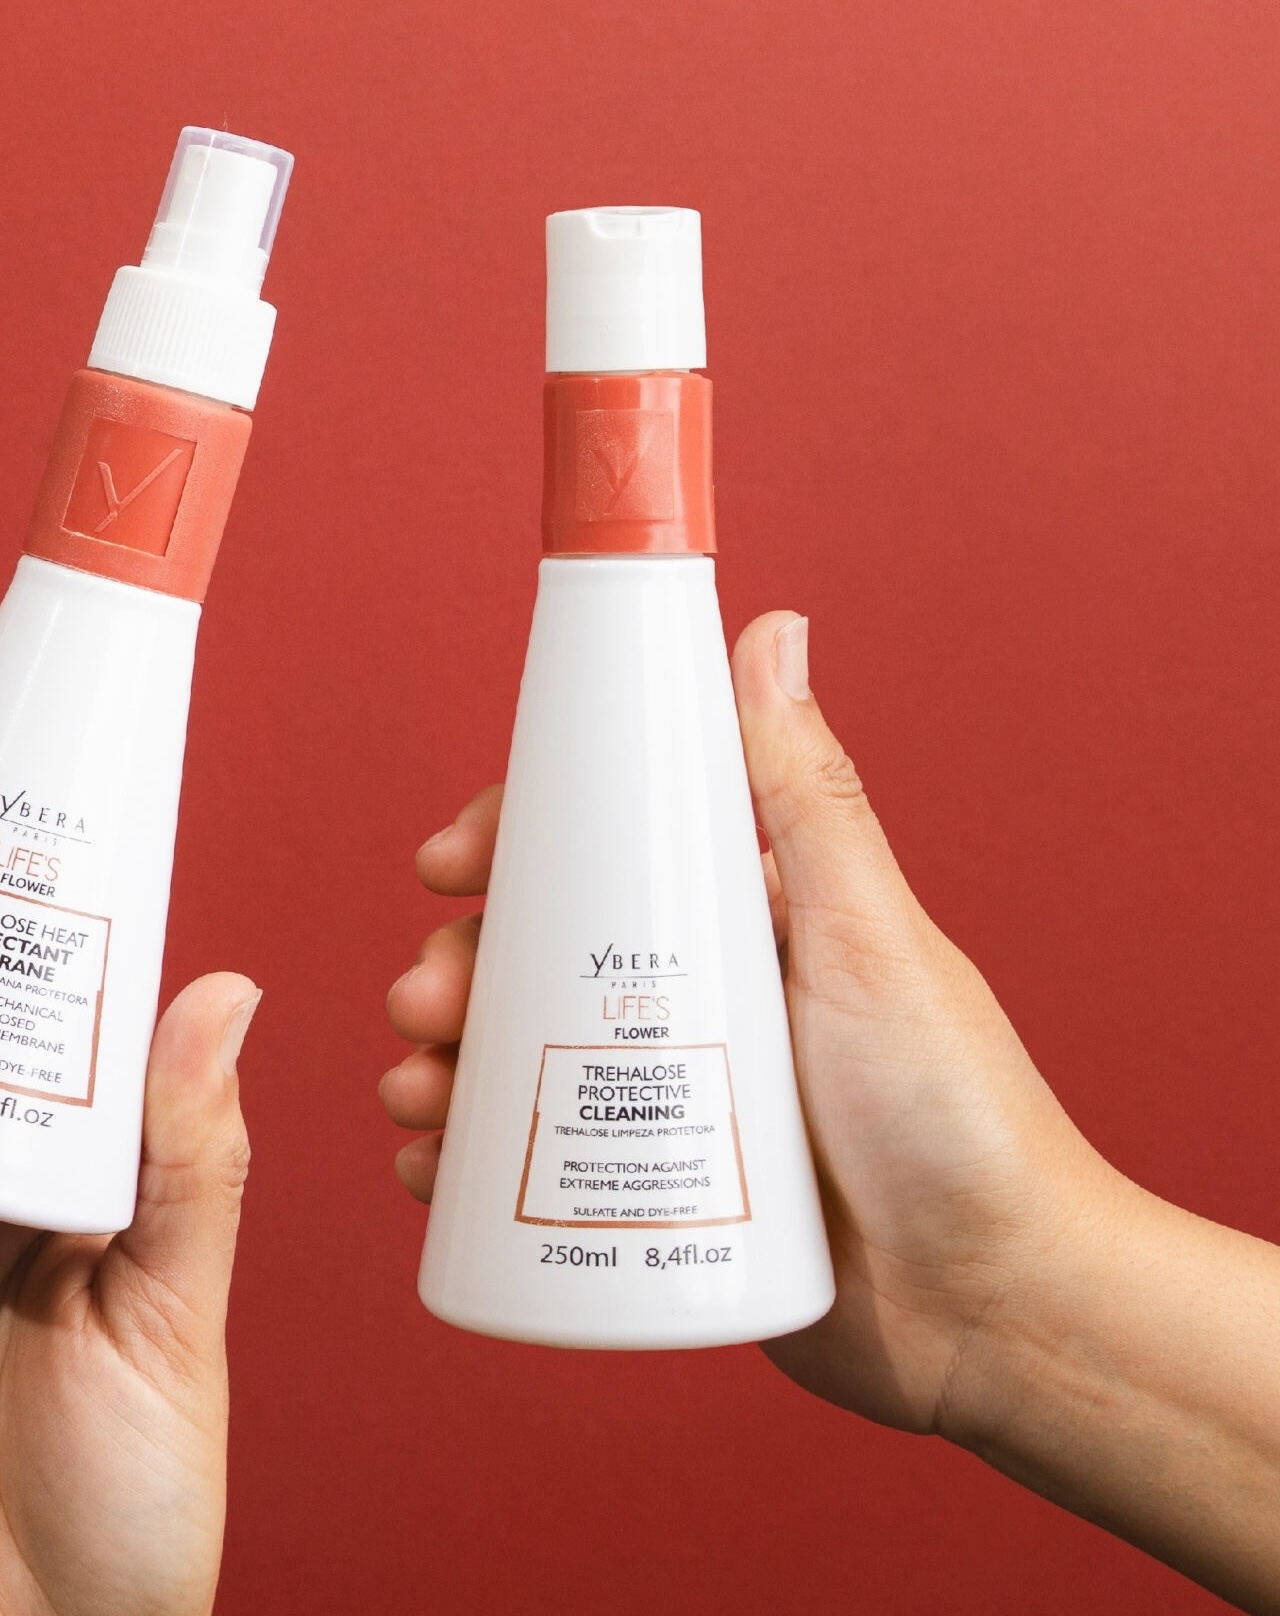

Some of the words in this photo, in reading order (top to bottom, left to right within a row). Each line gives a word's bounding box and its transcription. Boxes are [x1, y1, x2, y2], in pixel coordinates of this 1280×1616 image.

[0, 790, 86, 834] YBERA
[12, 826, 58, 846] PARIS
[0, 873, 56, 898] FLOWER
[41, 924, 89, 949] HEAT
[590, 943, 679, 978] YBERA
[612, 980, 656, 989] PARIS
[25, 984, 88, 1006] PROTETORA
[602, 996, 671, 1020] LIFE'S
[614, 1027, 670, 1039] FLOWER
[583, 1064, 686, 1081] TREHALOSE
[578, 1084, 691, 1102] PROTECTIVE
[579, 1105, 685, 1121] CLEANING
[554, 1126, 609, 1137] TREHALOSE
[612, 1127, 655, 1138] LIMPEZA
[657, 1124, 715, 1136] PROTETORA
[563, 1161, 648, 1173] PROTECTION
[651, 1159, 706, 1173] AGAINST
[560, 1178, 620, 1190] EXTREME
[622, 1176, 711, 1190] AGGRESSIONS
[573, 1206, 618, 1217] SULFATE
[620, 1207, 645, 1217] AND
[648, 1205, 697, 1217] DYE-FREE
[540, 1244, 617, 1267] 250ml
